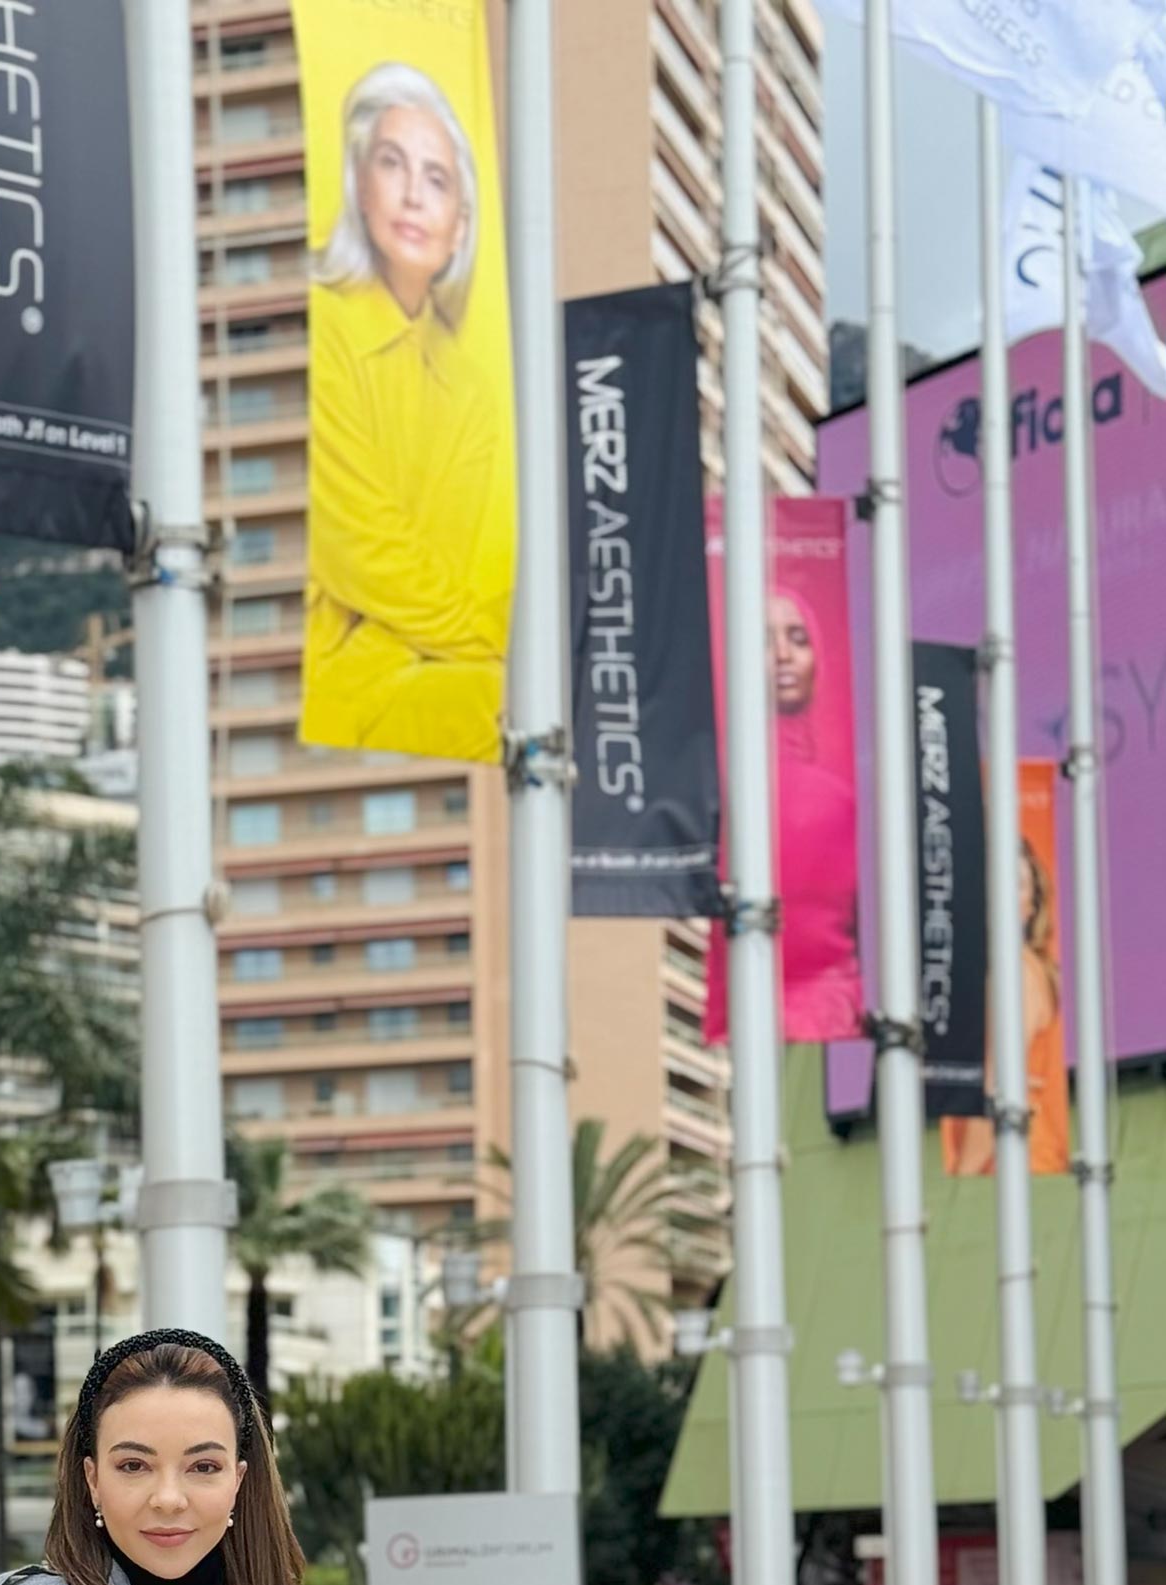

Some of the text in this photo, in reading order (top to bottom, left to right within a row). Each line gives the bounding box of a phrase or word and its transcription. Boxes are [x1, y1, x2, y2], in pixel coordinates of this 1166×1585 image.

[45, 425, 67, 446] on
[68, 424, 116, 456] Level
[575, 355, 628, 493] MERZ
[917, 685, 950, 794] MERZ
